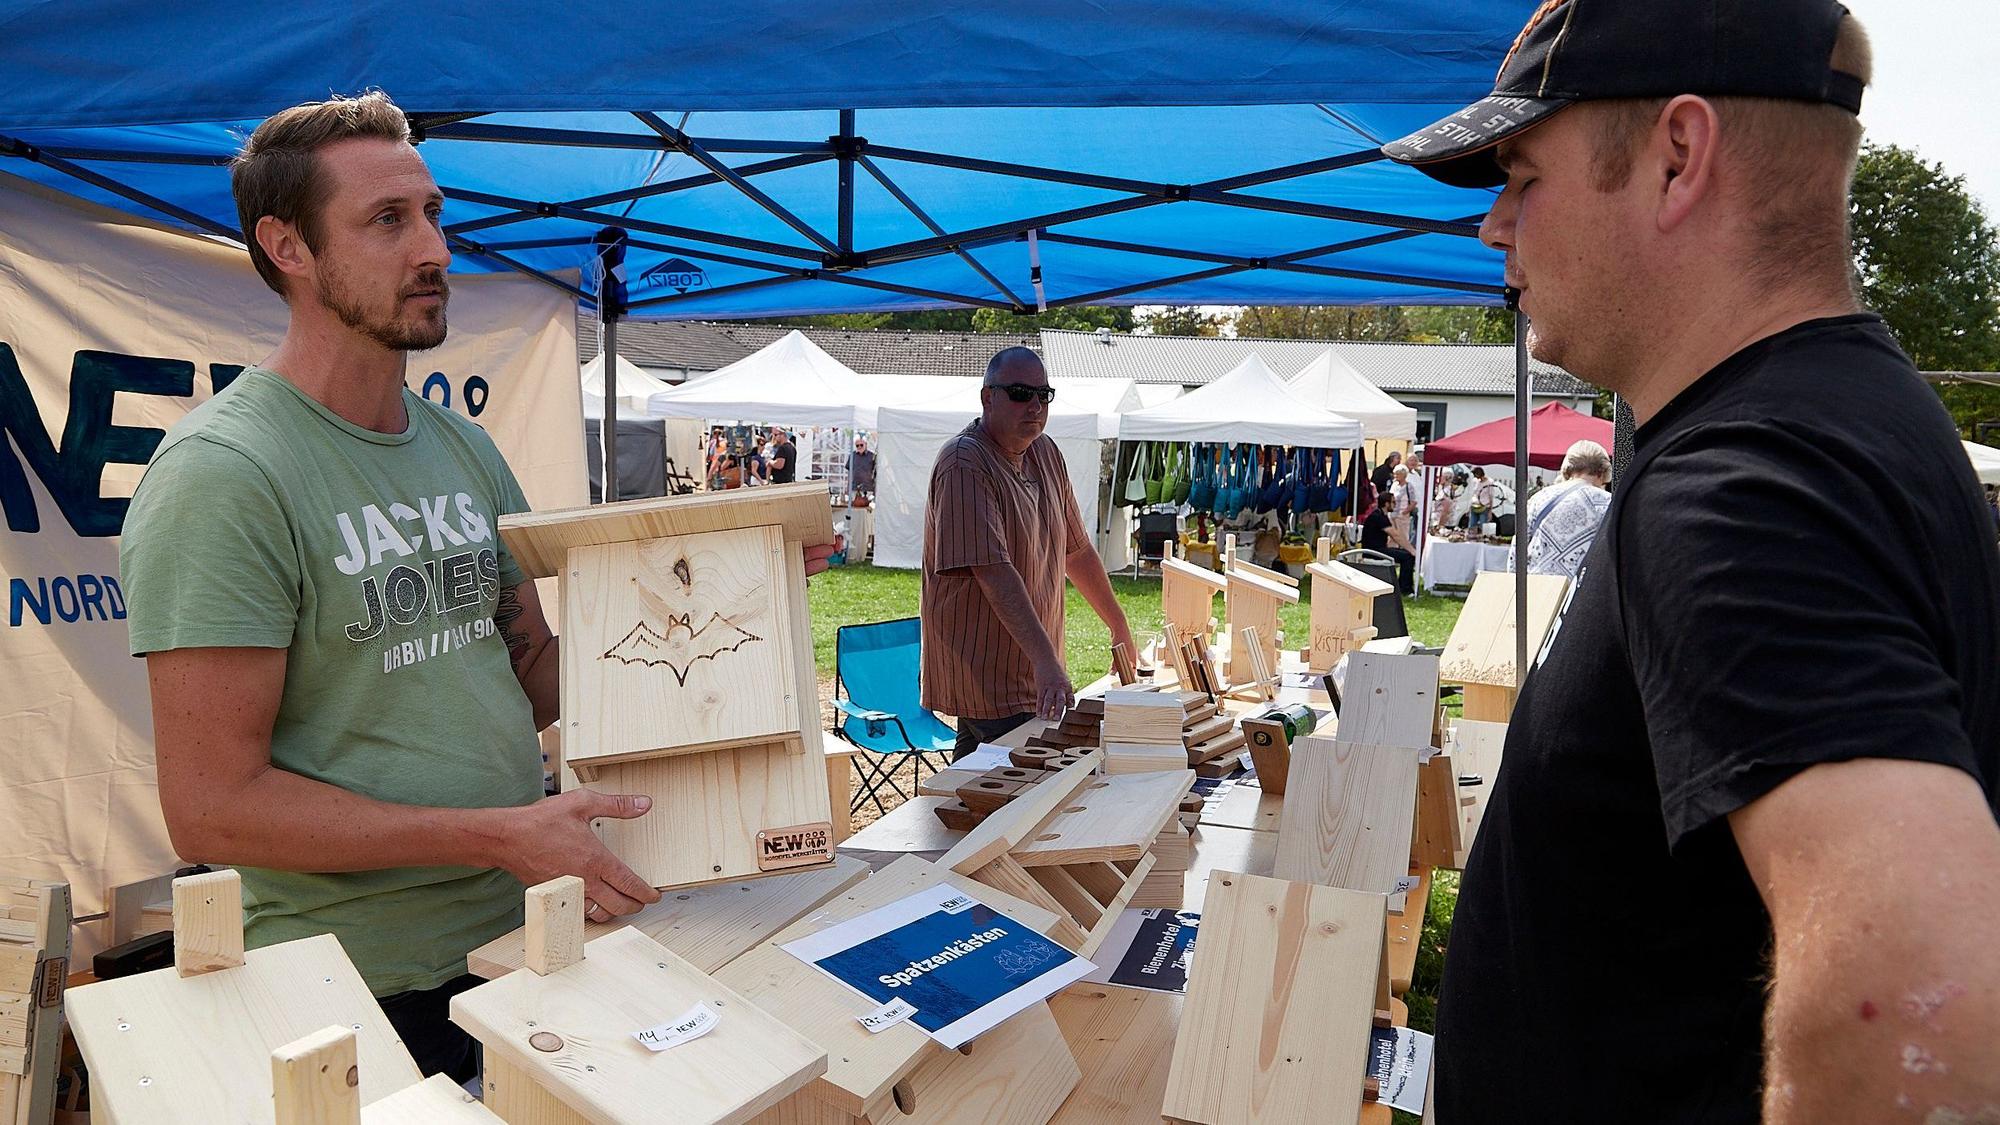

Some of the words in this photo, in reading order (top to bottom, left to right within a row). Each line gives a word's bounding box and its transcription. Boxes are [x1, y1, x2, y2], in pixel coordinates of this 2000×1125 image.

[0, 341, 247, 537] NE
[384, 637, 426, 674] URBN
[878, 926, 1009, 988] Spatzenkästen
[1140, 922, 1182, 975] Bienenhotel
